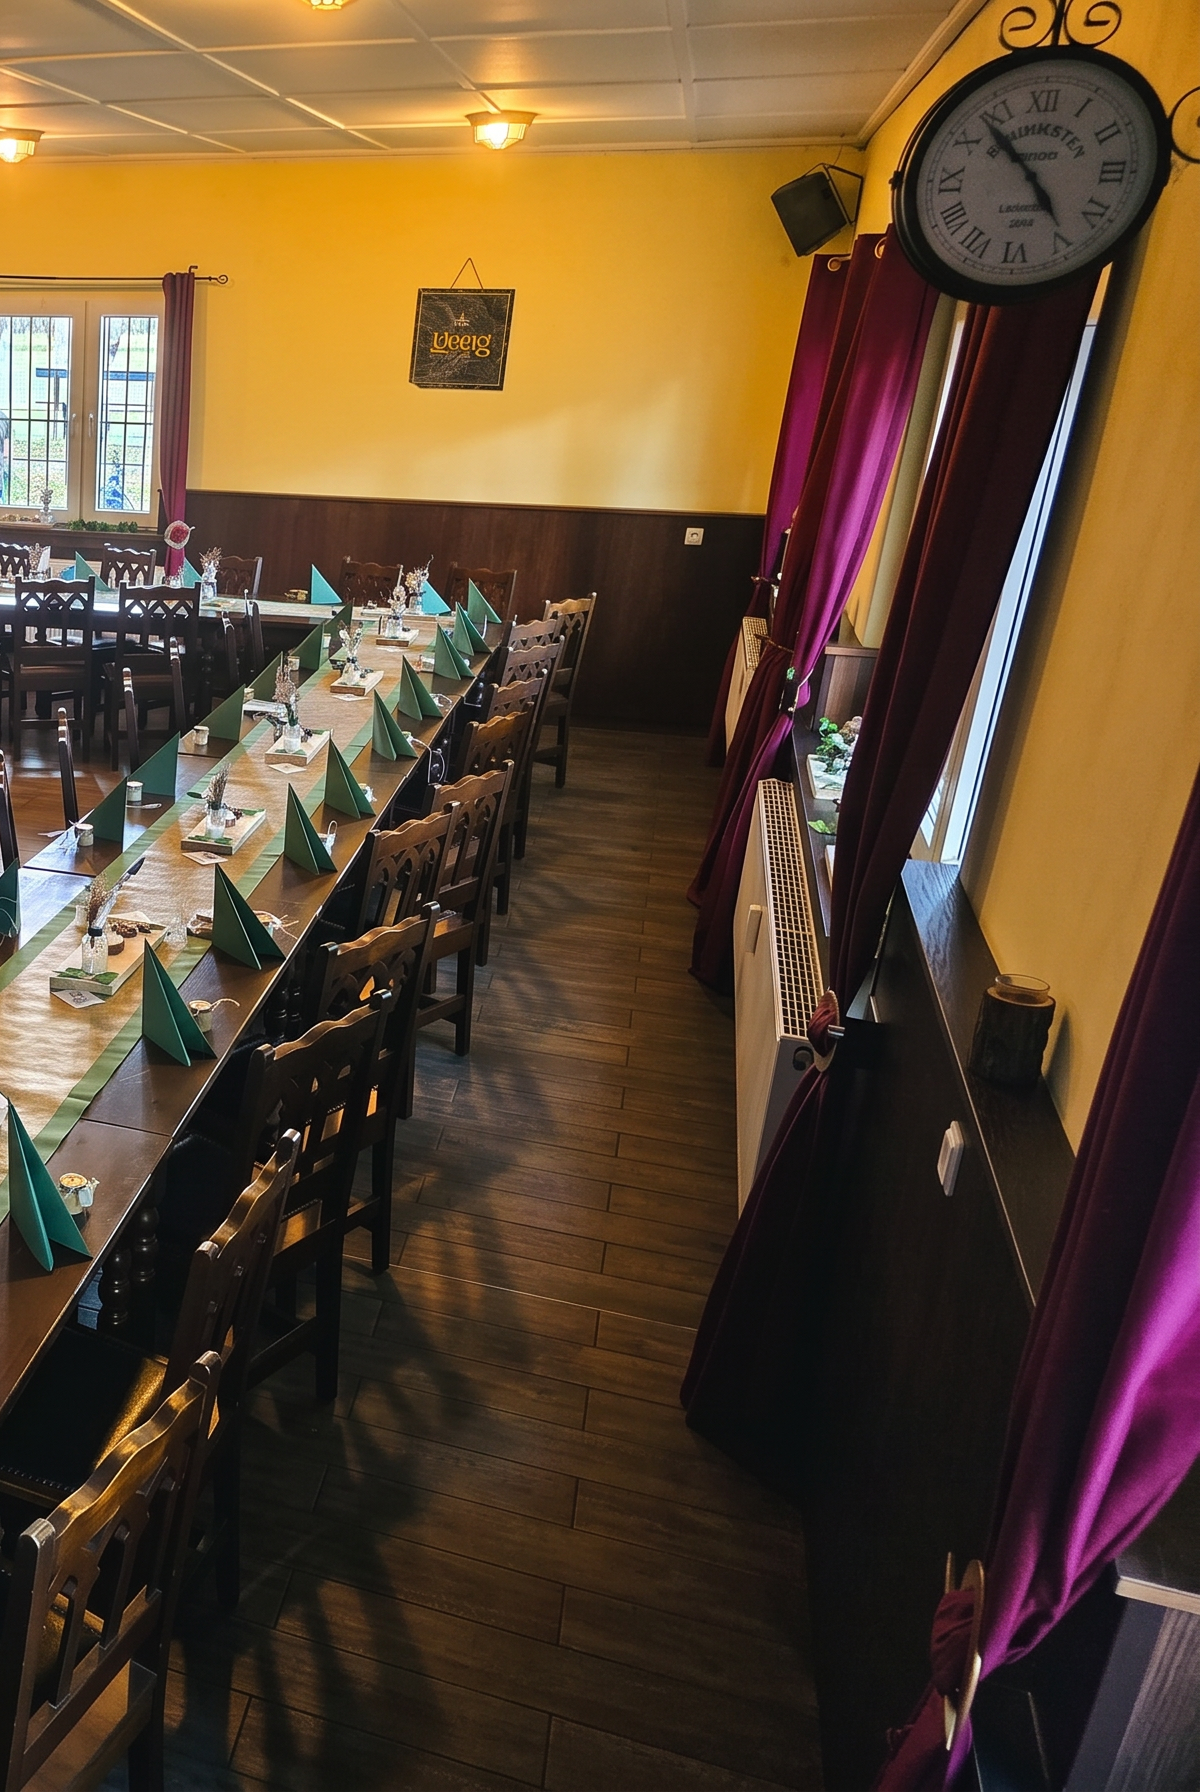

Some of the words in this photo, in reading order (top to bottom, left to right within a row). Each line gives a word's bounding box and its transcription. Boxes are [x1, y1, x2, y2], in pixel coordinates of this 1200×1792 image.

[982, 99, 1015, 126] XI
[1025, 89, 1061, 114] XII
[1074, 97, 1094, 118] I
[953, 129, 982, 155] X
[1095, 120, 1122, 145] II
[938, 165, 966, 195] IX
[1099, 160, 1127, 186] III
[940, 200, 970, 236] VIII
[1081, 196, 1111, 229] IV
[958, 226, 992, 259] VII
[1001, 241, 1028, 264] VI
[1049, 231, 1074, 255] V
